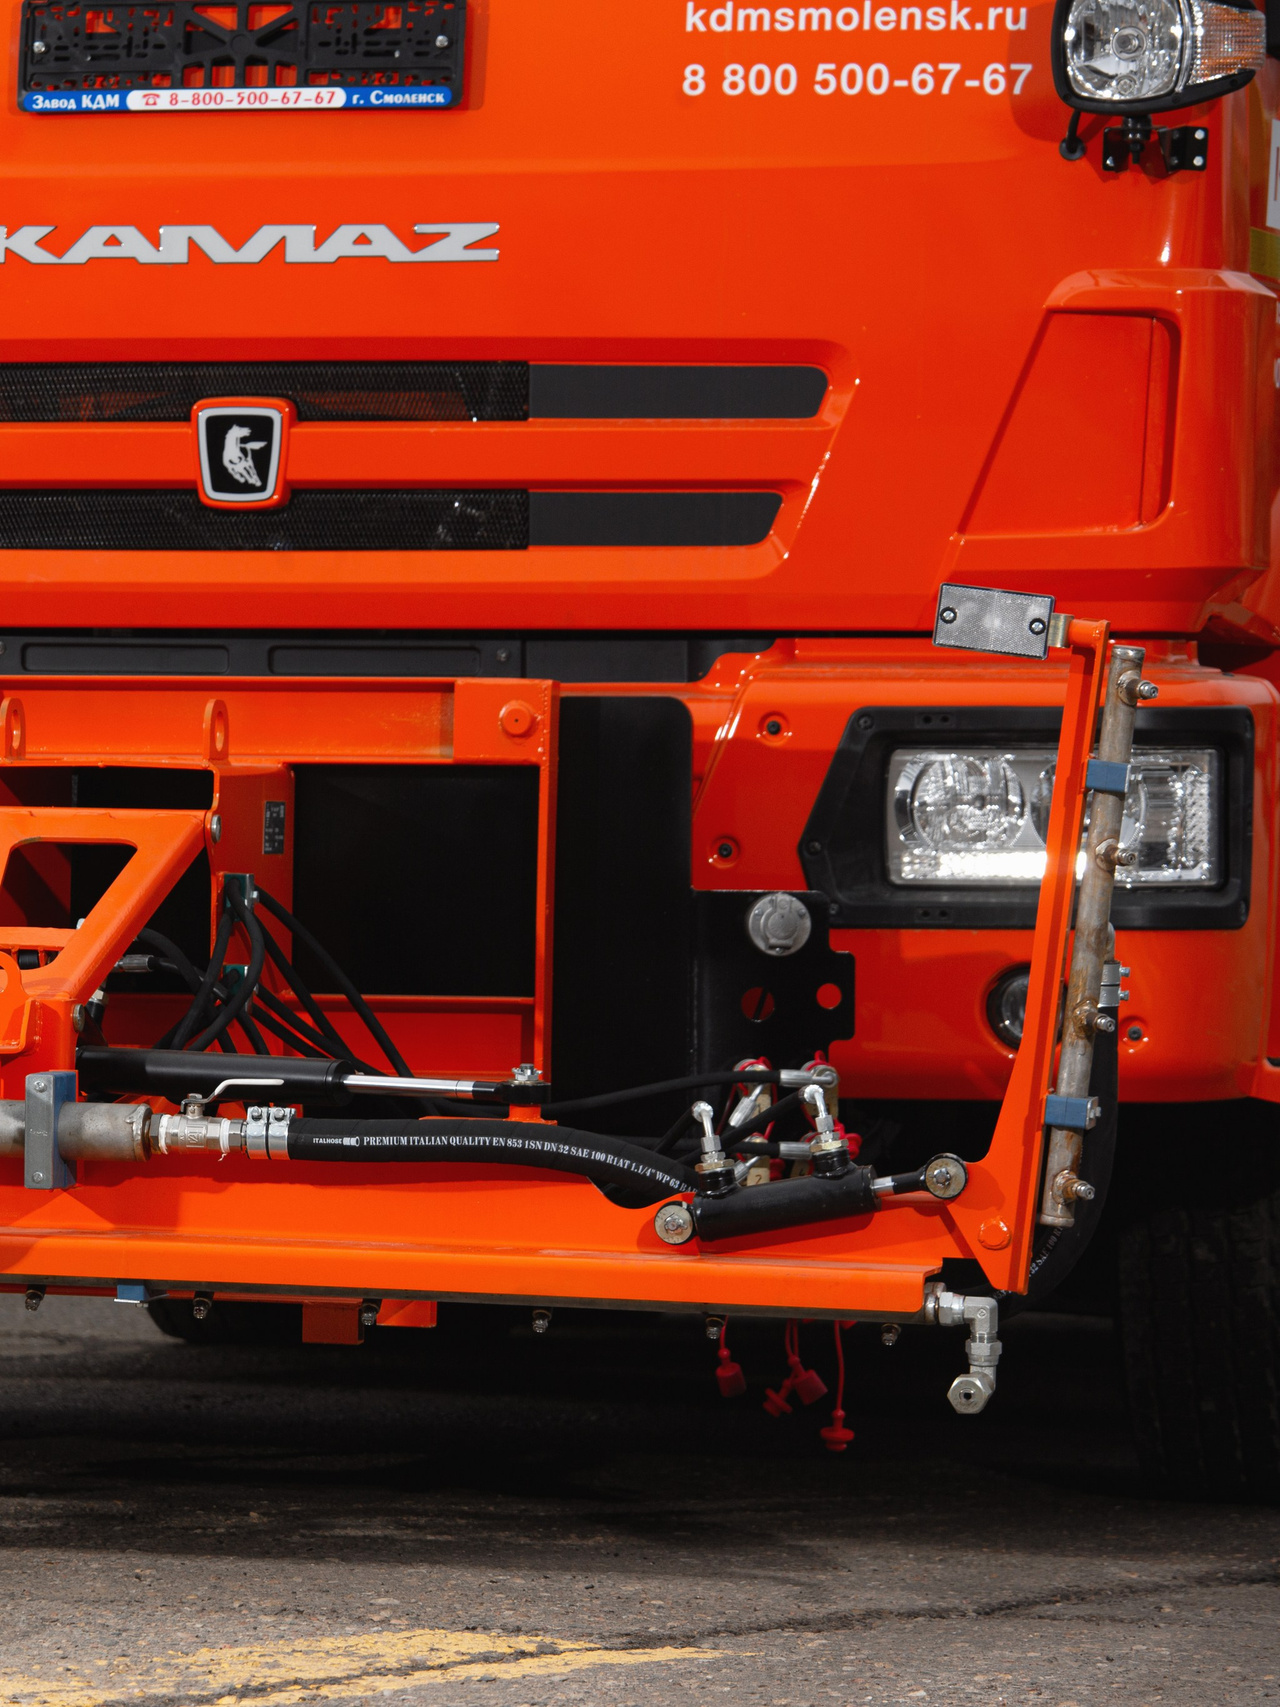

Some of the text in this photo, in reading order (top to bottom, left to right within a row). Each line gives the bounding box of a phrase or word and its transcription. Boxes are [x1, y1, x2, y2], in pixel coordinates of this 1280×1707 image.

[685, 1, 1027, 33] kdmsmolensk.ru
[682, 62, 1033, 96] 8 800 500-67-67
[81, 93, 120, 109] КДМ
[169, 91, 336, 106] 8-800-500-67-67
[363, 1136, 408, 1146] PREMIUM
[409, 1136, 448, 1146] ITALIAN
[449, 1136, 492, 1147] QUALITY
[492, 1137, 506, 1147] EN
[506, 1138, 523, 1148] 853
[524, 1139, 542, 1150] 1SN
[543, 1141, 558, 1152] DN
[558, 1144, 569, 1154] 32
[570, 1146, 590, 1158] SAE
[590, 1150, 606, 1162] 100
[606, 1154, 631, 1169] R1AT
[655, 1170, 671, 1183] WP
[669, 1178, 681, 1189] 63
